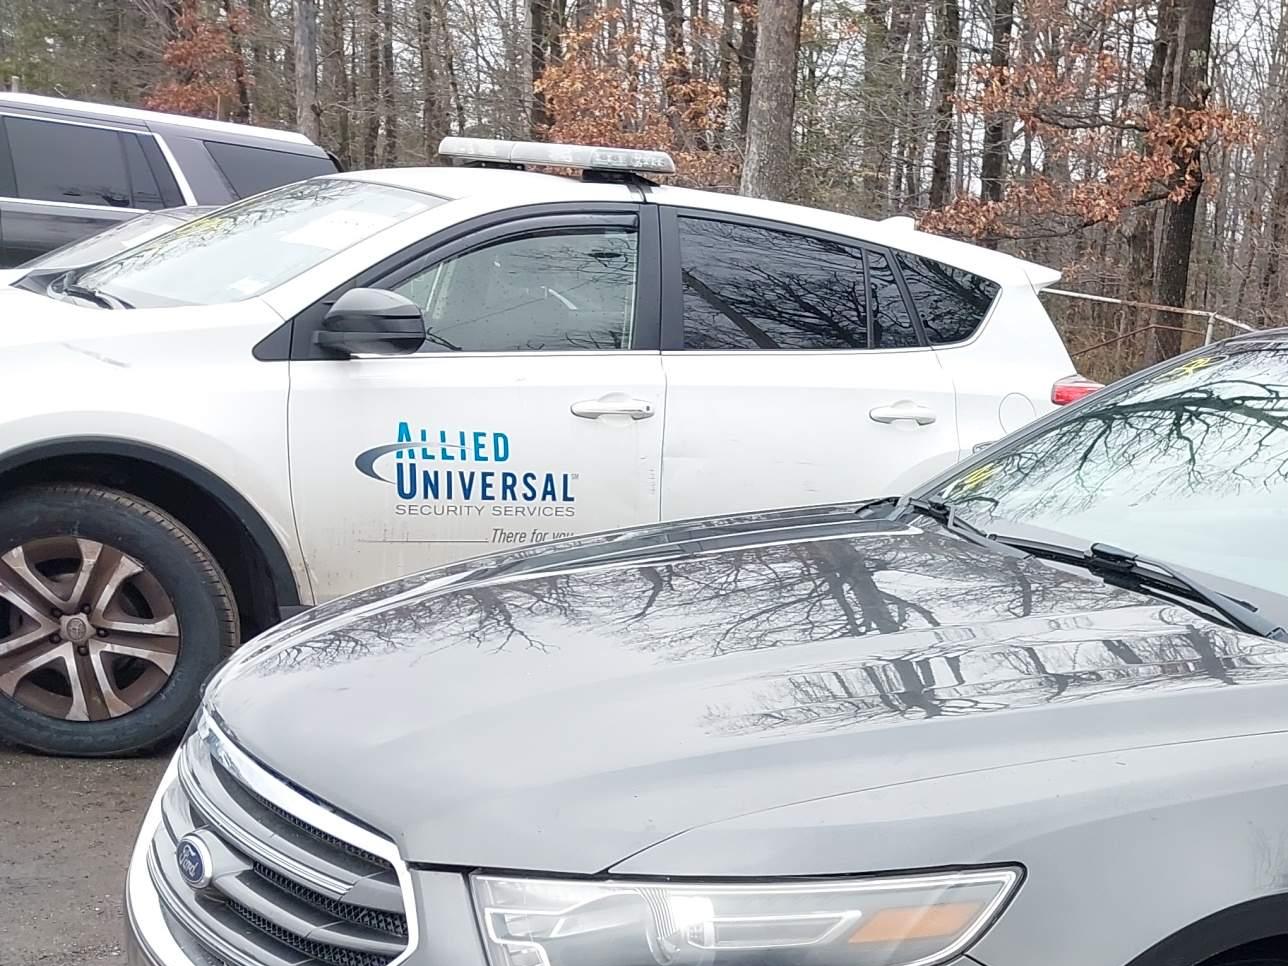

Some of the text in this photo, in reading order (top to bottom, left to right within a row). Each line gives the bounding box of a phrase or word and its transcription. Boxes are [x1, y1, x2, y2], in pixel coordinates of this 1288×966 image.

[396, 421, 510, 462] ALLIED
[396, 462, 576, 502] UNIVERSAL
[395, 504, 576, 518] SECURITY SERVICES
[491, 528, 527, 544] There
[531, 529, 550, 544] for
[180, 844, 200, 878] Ford
